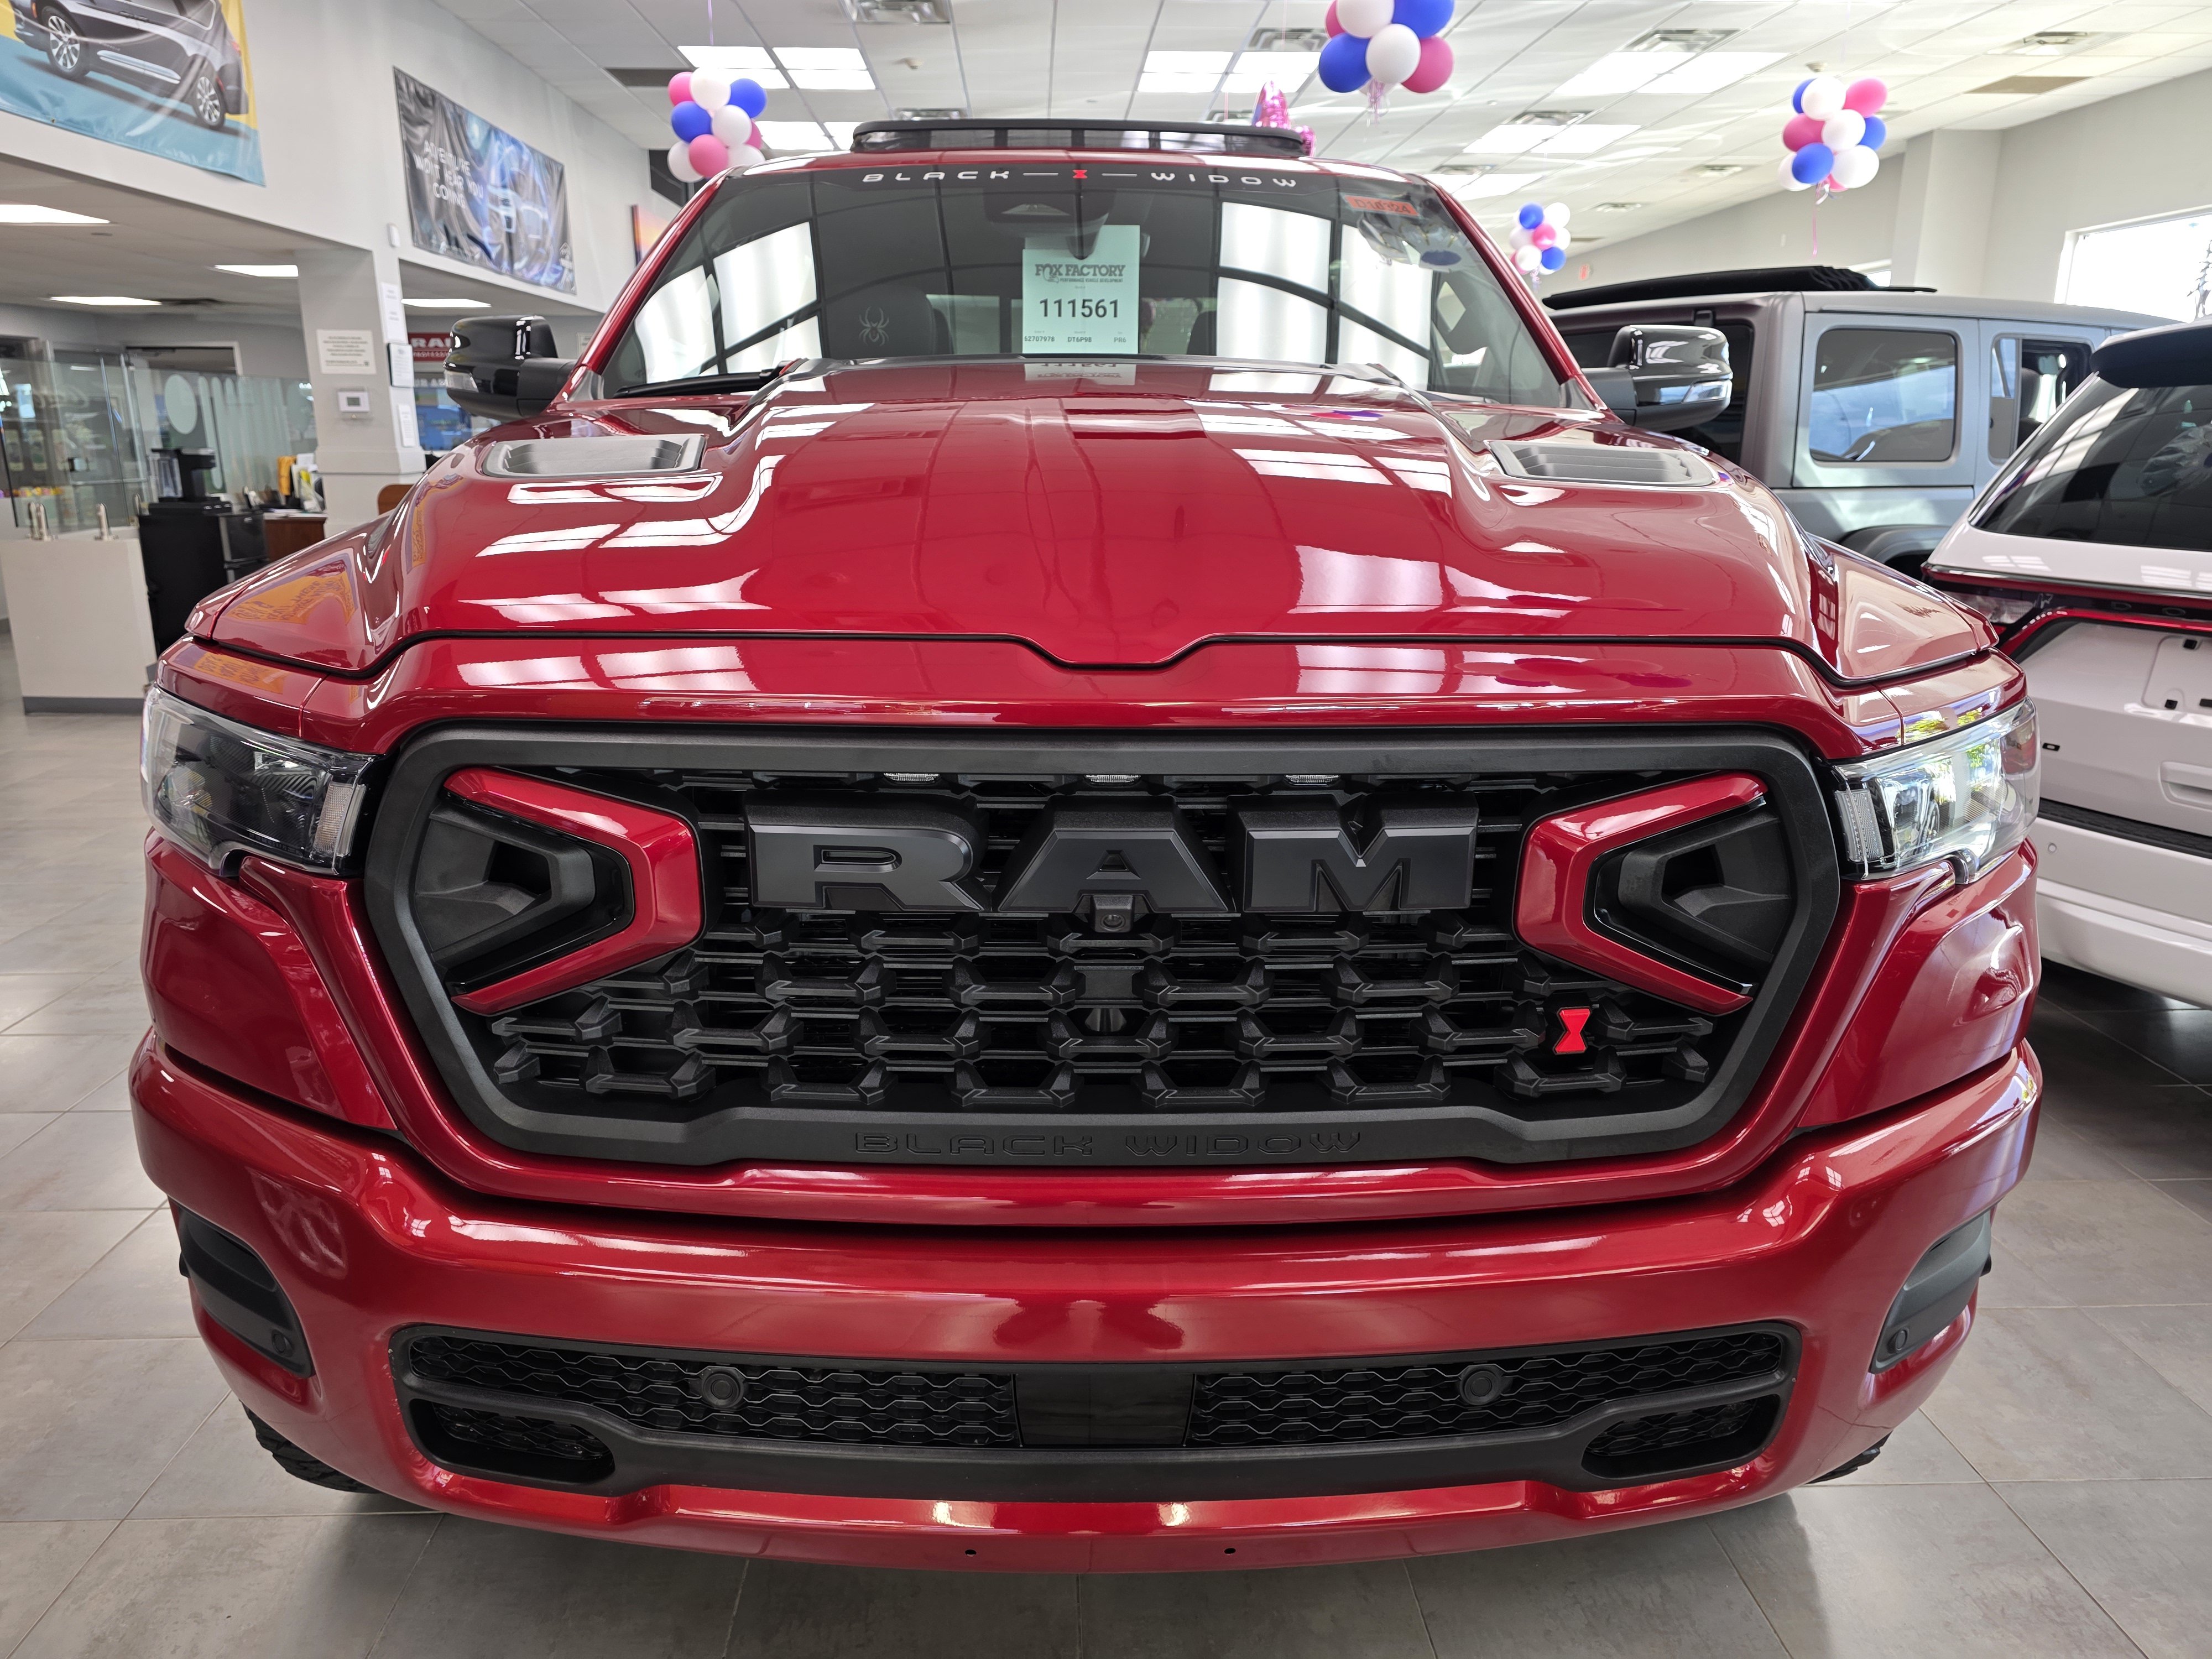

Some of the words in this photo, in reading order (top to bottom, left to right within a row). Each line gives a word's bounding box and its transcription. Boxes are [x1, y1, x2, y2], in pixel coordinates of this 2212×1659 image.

[862, 171, 1009, 182] BLACK
[1151, 173, 1296, 187] WIDOW
[1065, 264, 1126, 277] FACTORY
[1040, 298, 1119, 318] 111561
[745, 799, 1478, 914] RAM
[855, 1131, 1093, 1156] BLACK
[1125, 1130, 1360, 1156] WIDOW
